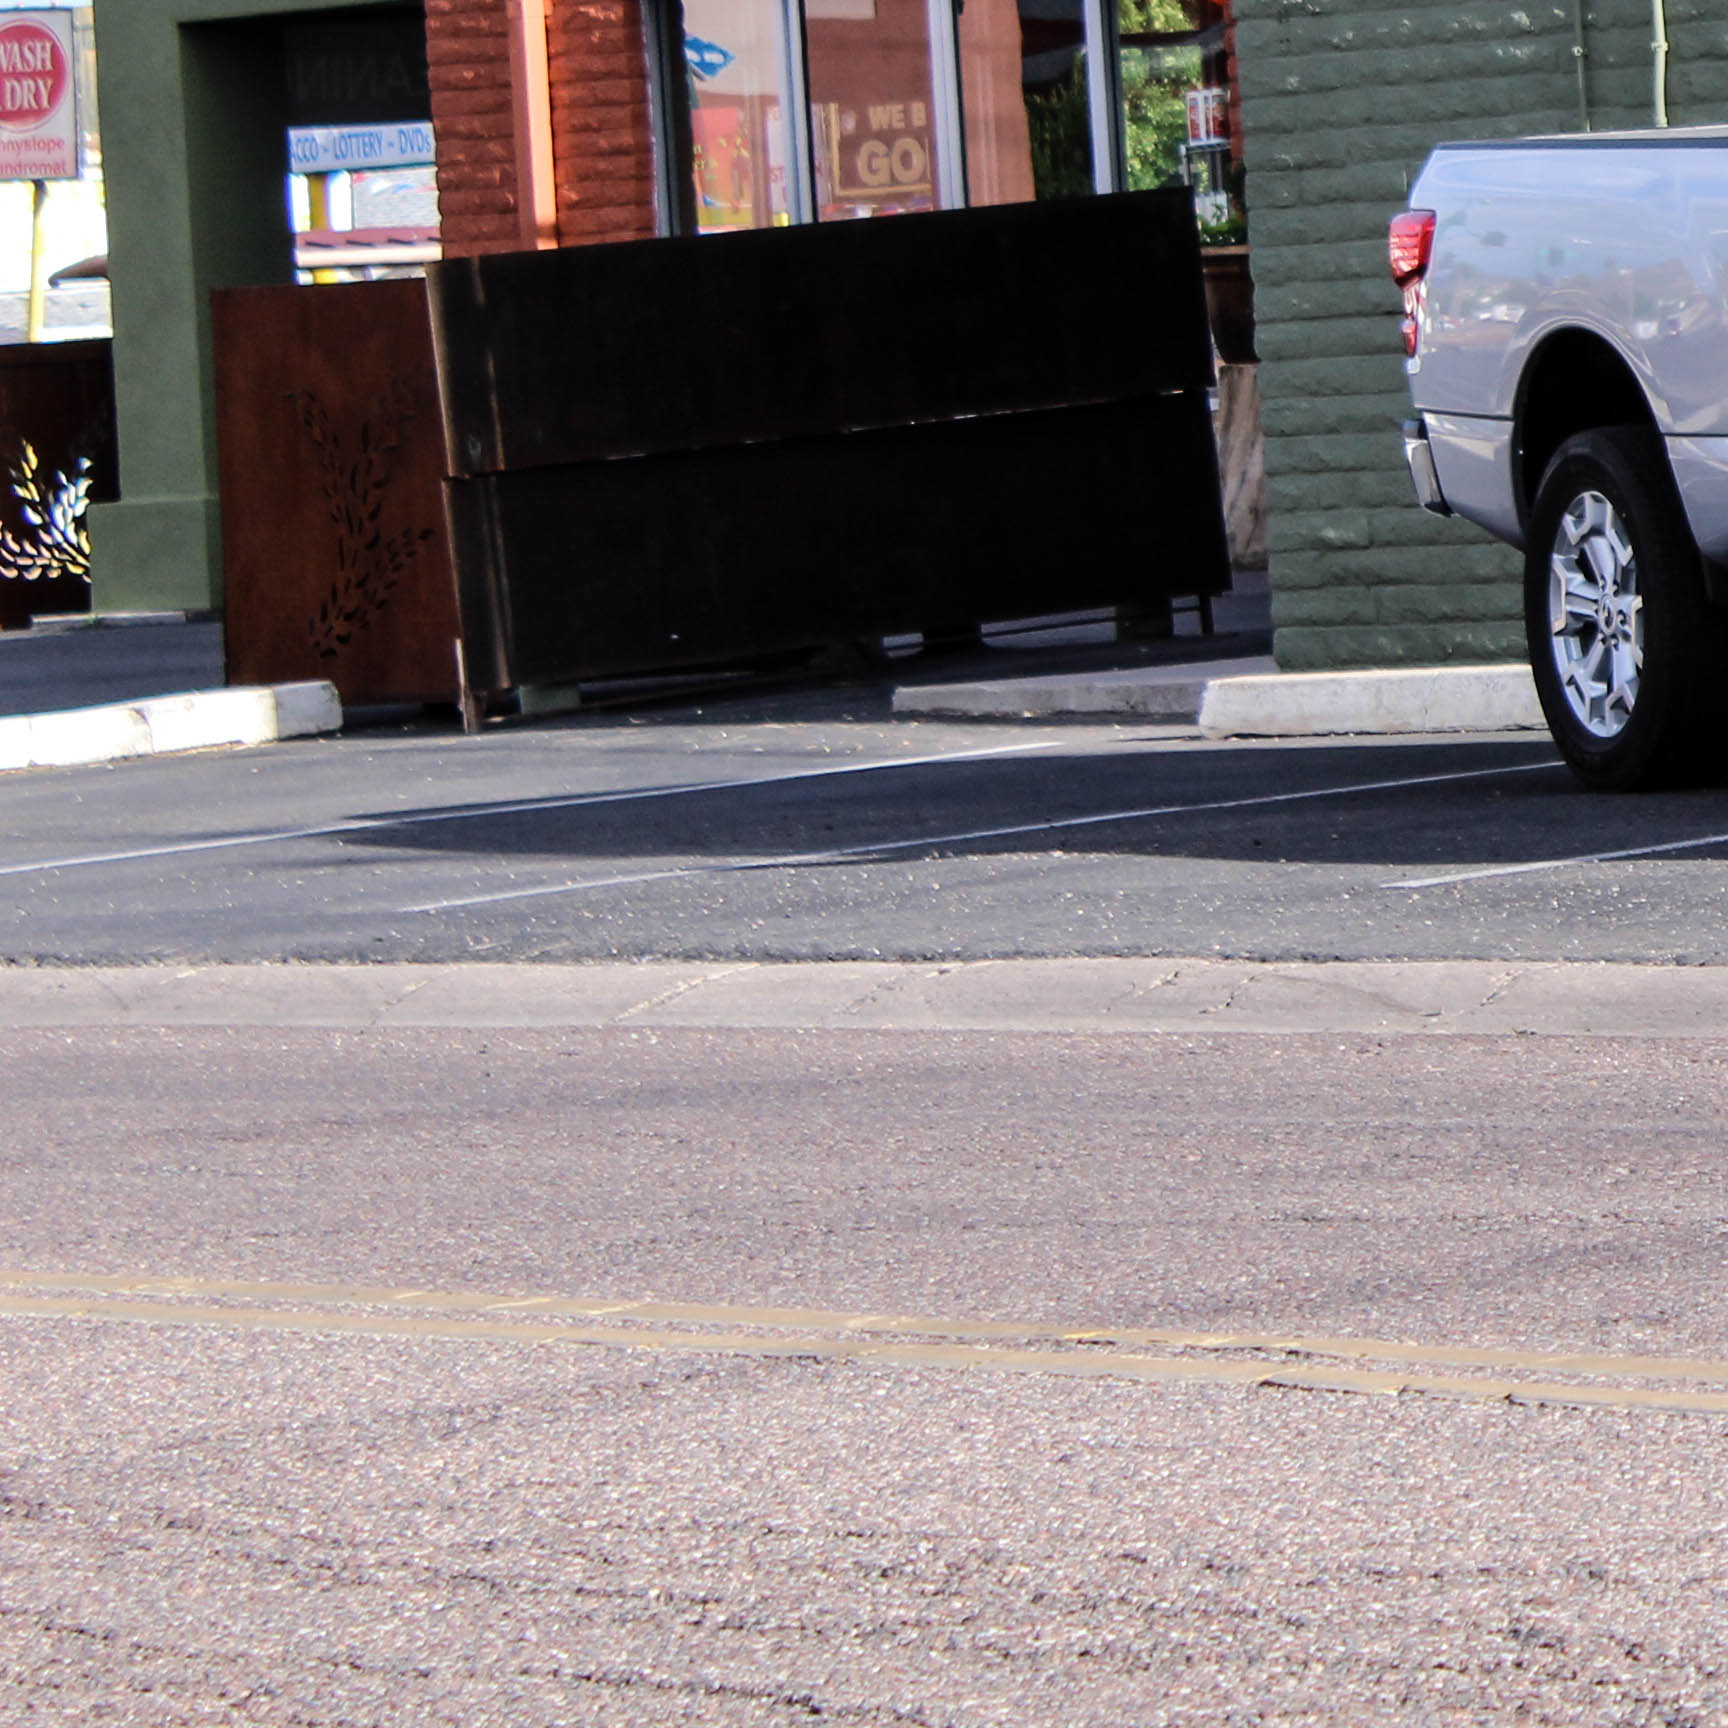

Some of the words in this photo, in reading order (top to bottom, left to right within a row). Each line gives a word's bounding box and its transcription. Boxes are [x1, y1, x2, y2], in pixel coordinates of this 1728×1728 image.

[5, 79, 53, 111] DRY
[868, 103, 905, 131] WE
[333, 131, 383, 161] LOTTERY
[398, 128, 431, 154] DVDs
[857, 137, 929, 186] GO
